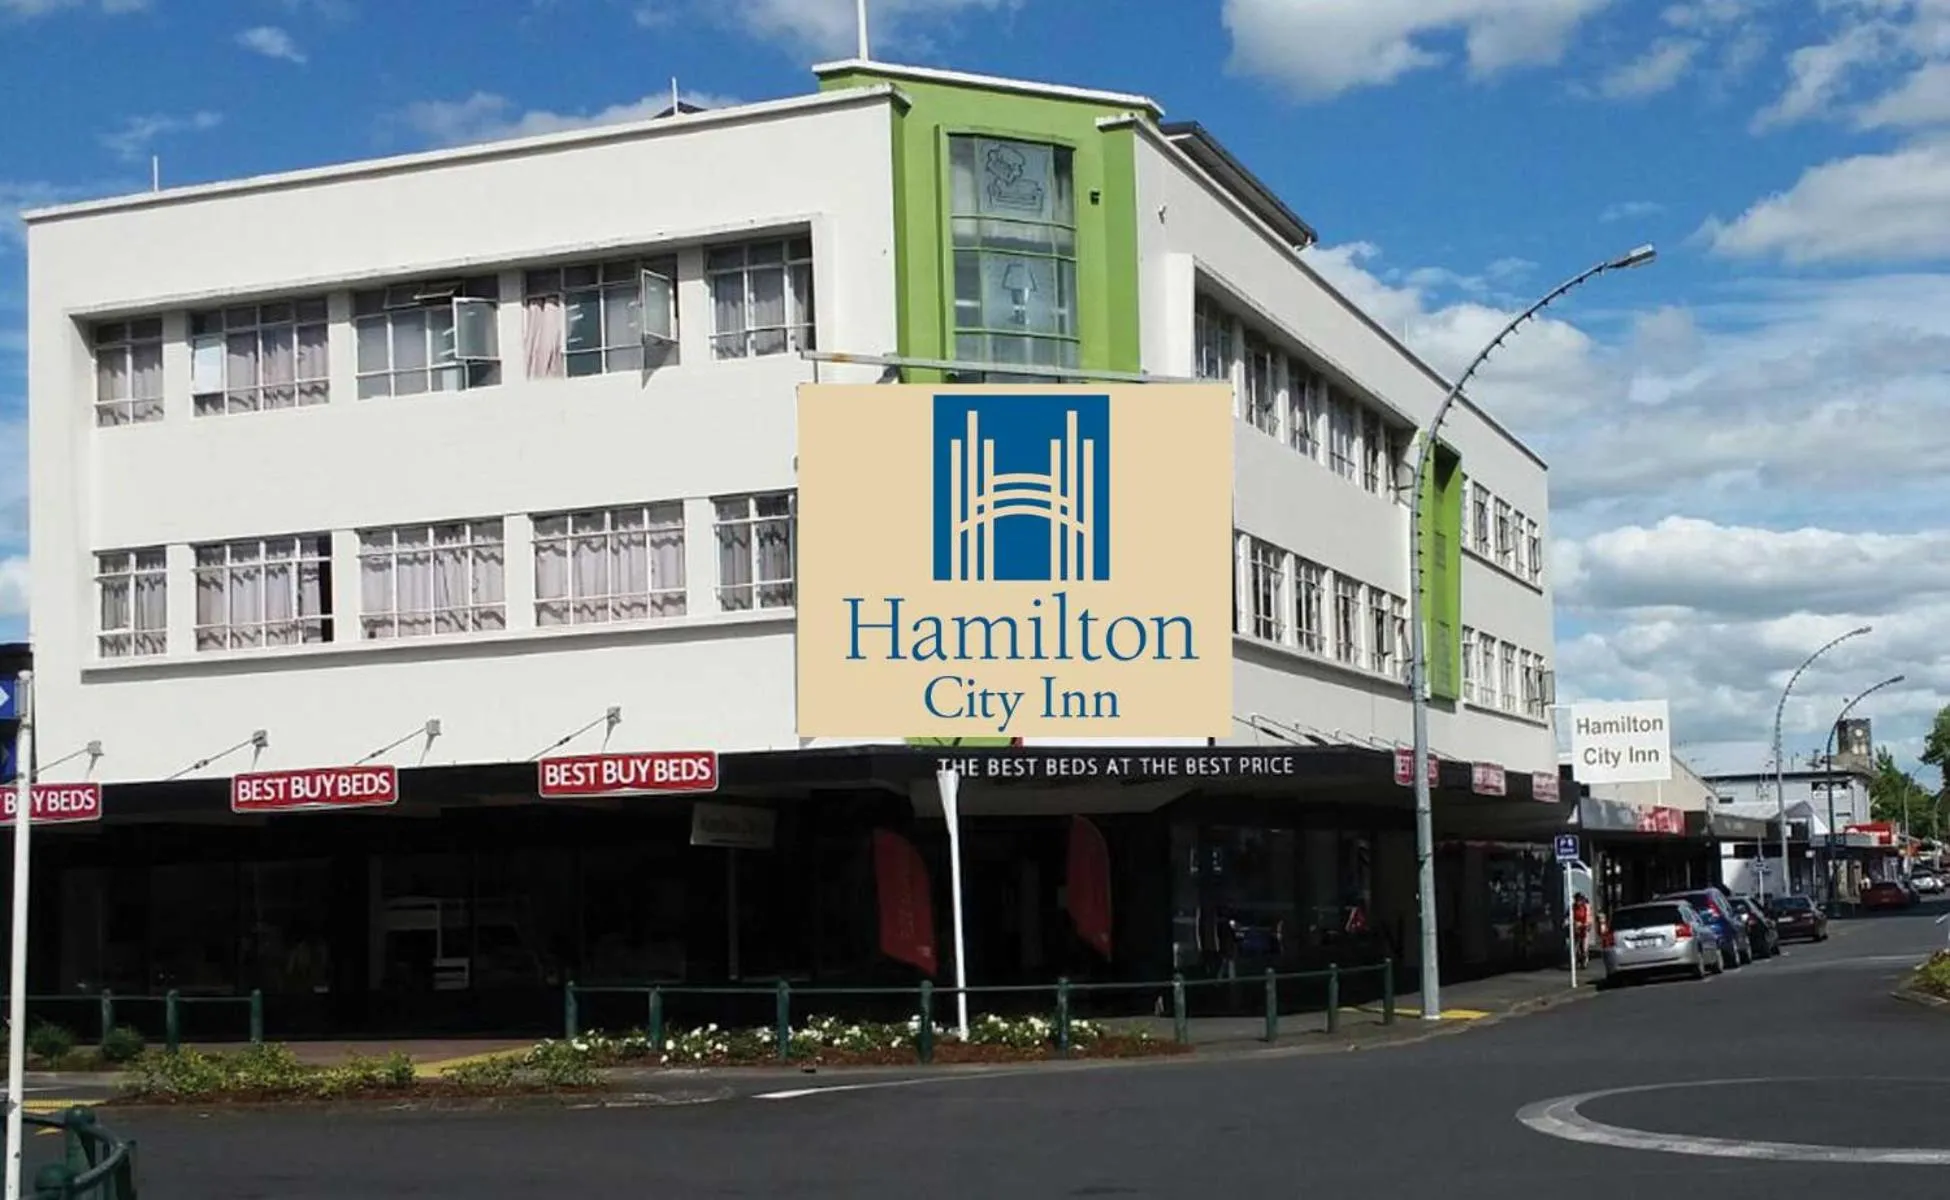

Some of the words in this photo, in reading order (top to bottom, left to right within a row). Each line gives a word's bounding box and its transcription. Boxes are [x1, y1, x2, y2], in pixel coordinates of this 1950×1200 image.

[843, 592, 1199, 661] Hamilton
[924, 676, 1024, 732] City
[1041, 677, 1120, 718] Inn
[1576, 716, 1663, 735] Hamilton
[937, 758, 979, 776] THE
[987, 758, 1038, 776] BEST
[1045, 758, 1098, 776] BEDS
[1106, 758, 1131, 775] AT
[1139, 757, 1178, 775] THE
[1186, 757, 1232, 775] BEST
[1239, 757, 1294, 774] PRICE
[1583, 747, 1622, 768] City
[1628, 745, 1660, 764] Inn
[545, 763, 599, 786] BEST
[602, 758, 652, 784] BUY
[654, 757, 712, 782] BEDS
[237, 778, 288, 802] BEST
[290, 774, 336, 799] BUY
[338, 772, 391, 797] BEDS
[4, 790, 45, 815] BY
[47, 788, 96, 812] BEDS
